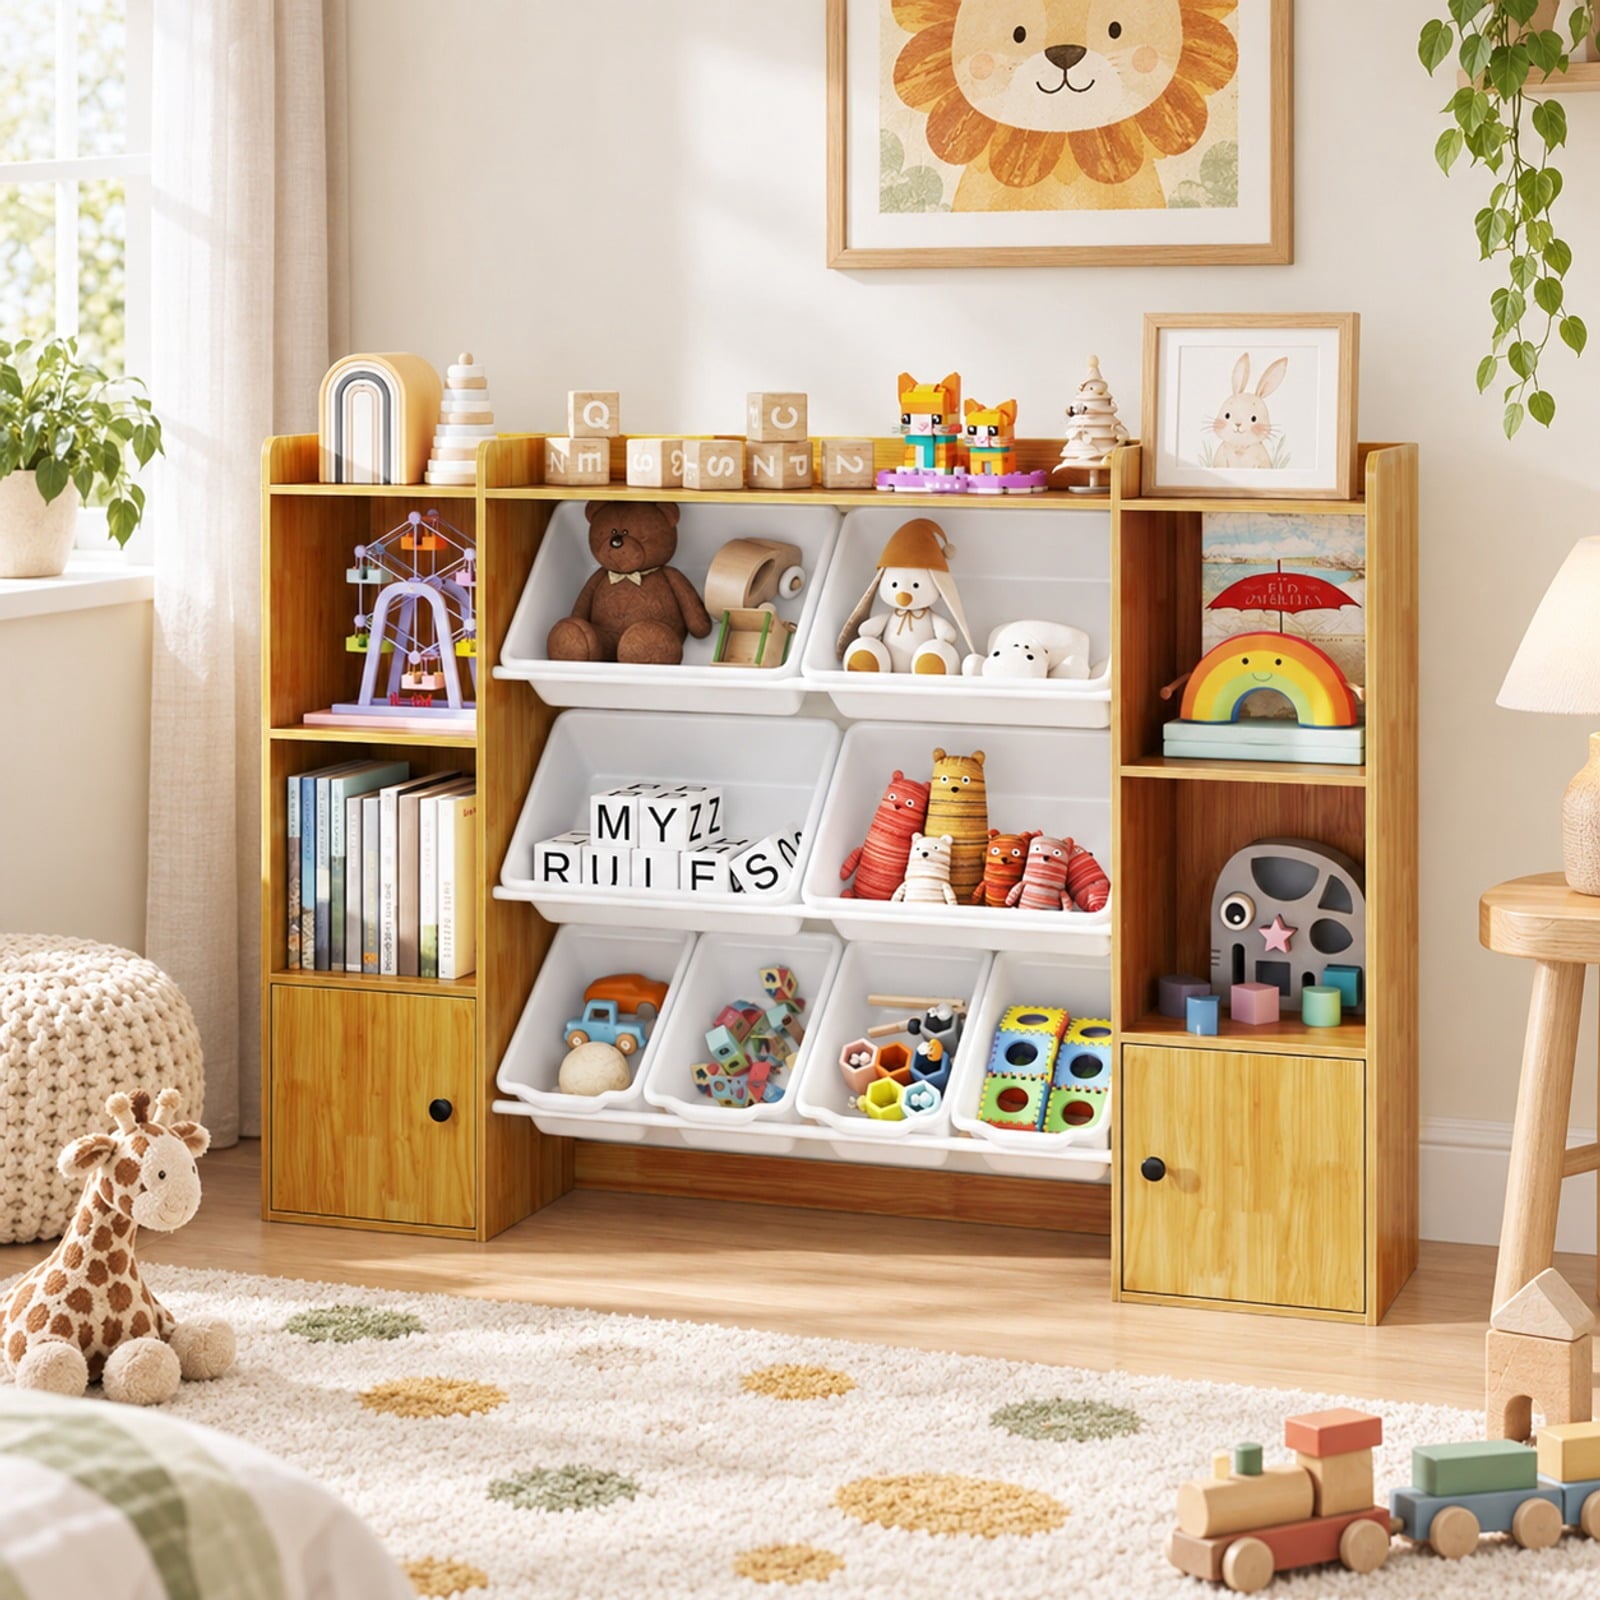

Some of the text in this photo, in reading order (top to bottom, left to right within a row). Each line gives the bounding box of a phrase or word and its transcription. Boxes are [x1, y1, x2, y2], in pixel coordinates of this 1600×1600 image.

[583, 401, 610, 429] Q
[771, 406, 798, 429] C
[707, 456, 734, 477] S
